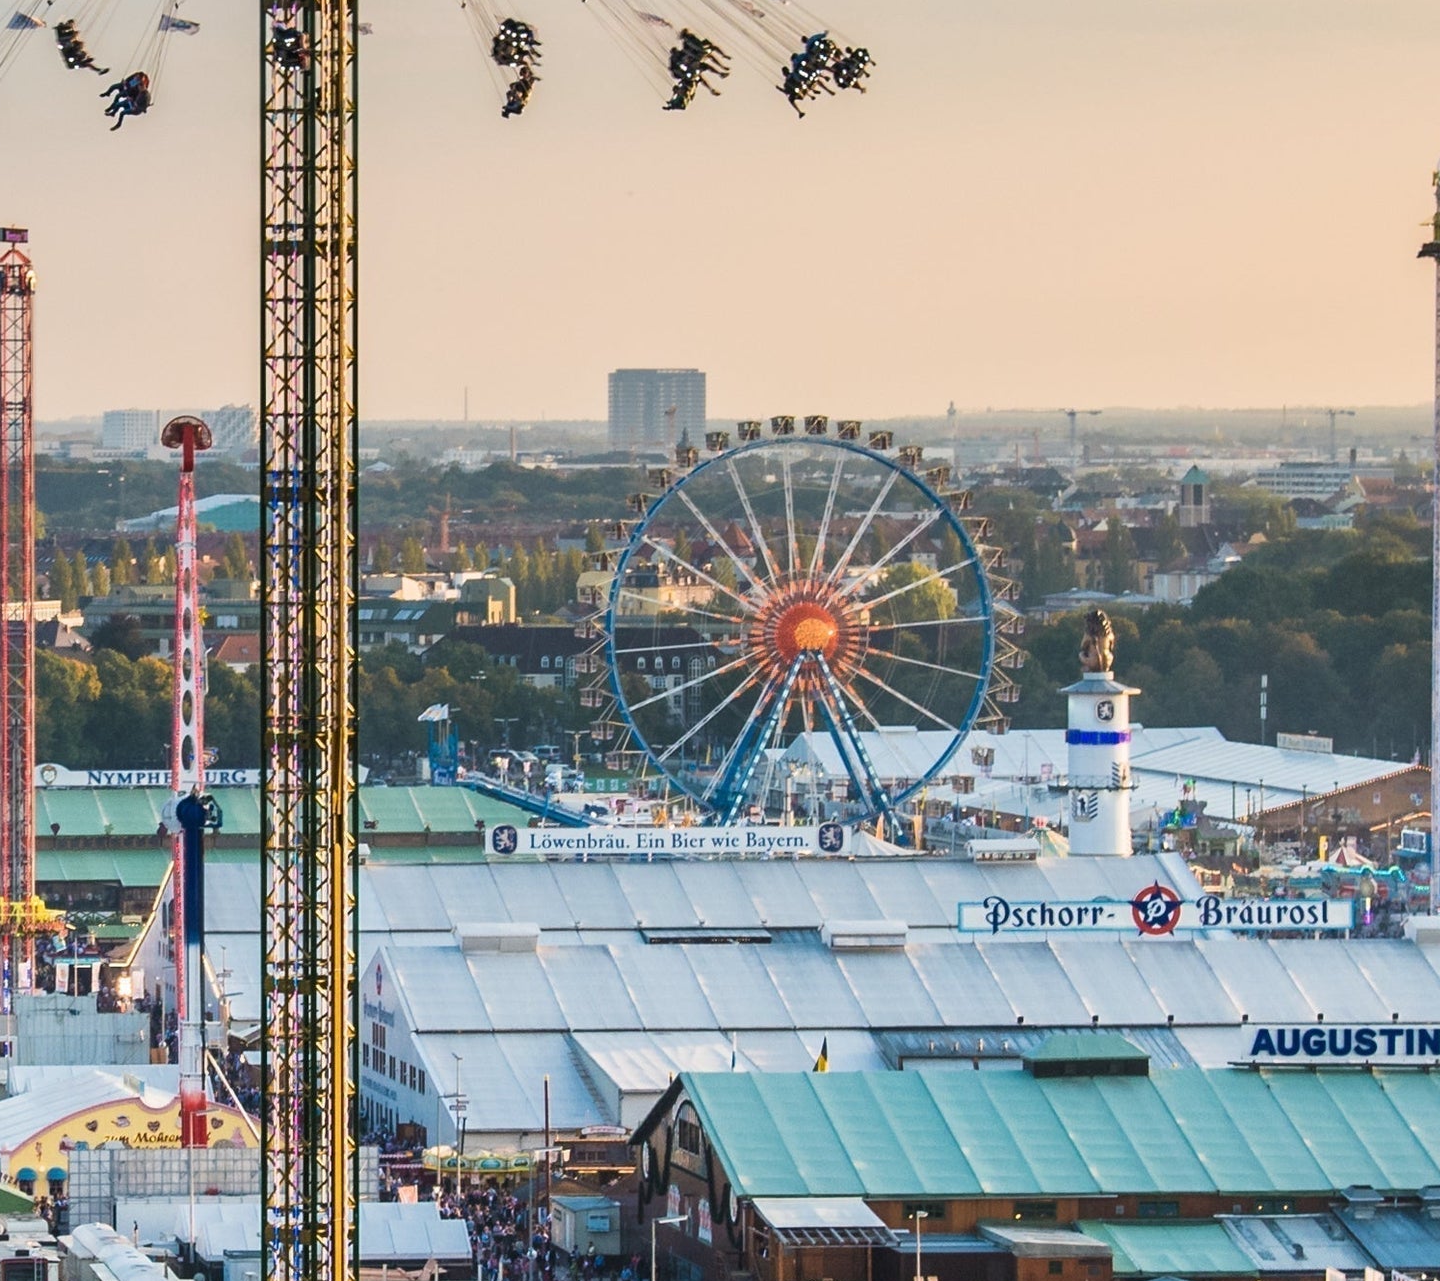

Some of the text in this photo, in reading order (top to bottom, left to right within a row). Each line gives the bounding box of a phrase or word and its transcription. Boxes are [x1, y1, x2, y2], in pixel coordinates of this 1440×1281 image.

[529, 832, 809, 854] Löwenbräu. Ein Bier wie Bayern.
[983, 896, 1116, 935] Pschorr-
[1197, 895, 1328, 926] Bräurosl
